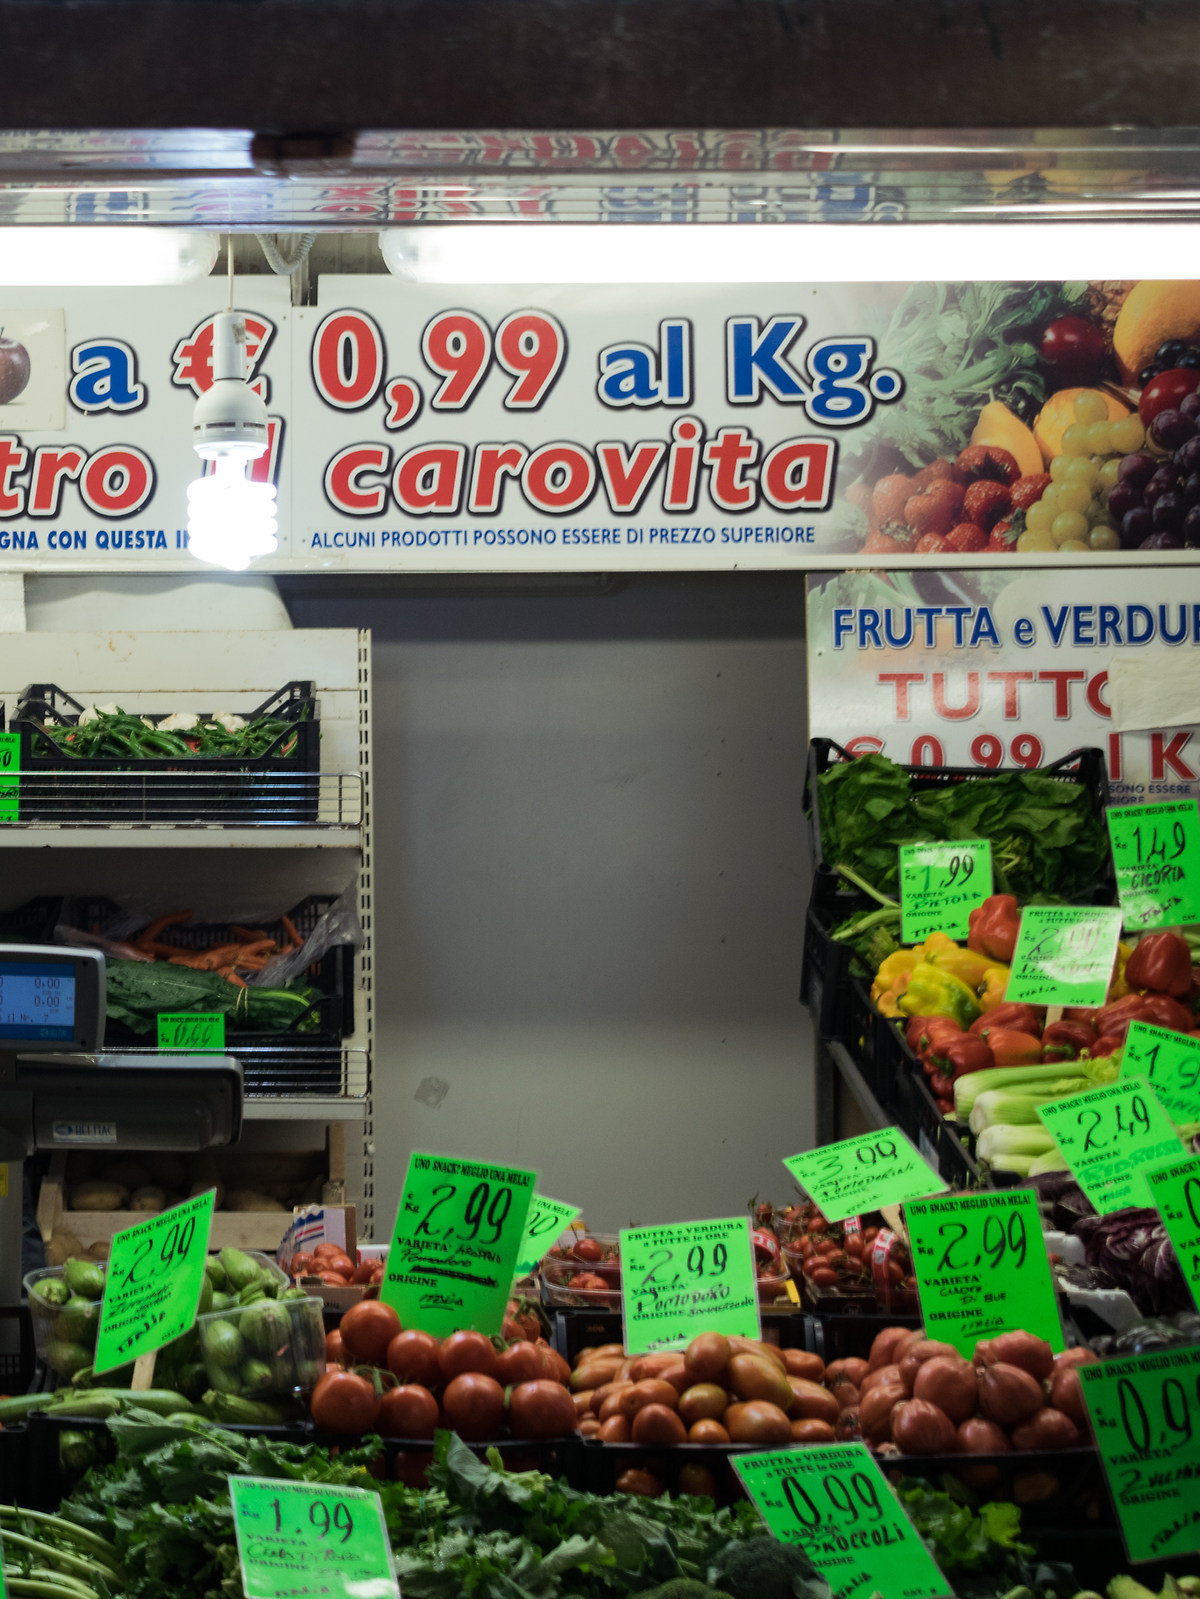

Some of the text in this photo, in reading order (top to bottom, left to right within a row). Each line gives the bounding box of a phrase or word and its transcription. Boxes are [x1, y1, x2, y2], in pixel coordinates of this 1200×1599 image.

[72, 340, 143, 411] a
[313, 308, 566, 430] 0,99
[598, 318, 691, 409] al
[726, 315, 904, 428] Kg.
[323, 417, 838, 517] carovita
[47, 530, 88, 550] CON
[96, 530, 167, 551] QUESTA
[311, 526, 815, 548] ALCUNI PRODOTTI POSSONO ESSERE DI PREZZO SUPERIORE
[832, 605, 1001, 649] FRUTTA
[1013, 615, 1036, 648] e
[1148, 784, 1191, 794] ESSERE
[1041, 1105, 1058, 1117] UNO
[414, 1157, 531, 1187] UNO SNACK? MEGLIO UNA MELA!
[1151, 1171, 1168, 1185] UNO
[413, 1182, 513, 1245] 2,99
[909, 1194, 1031, 1216] UNO SNACK? MEGLIO UNA MELA!
[936, 1210, 1027, 1273] 2,99
[388, 1273, 438, 1288] ORIGINE
[929, 1308, 984, 1321] ORIGINE
[1082, 1366, 1103, 1382] UNO
[1137, 1357, 1171, 1373] MEGLIO
[1170, 1353, 1190, 1368] UNA
[781, 1471, 884, 1528] 0,99
[1120, 1488, 1181, 1507] ORIGINE
